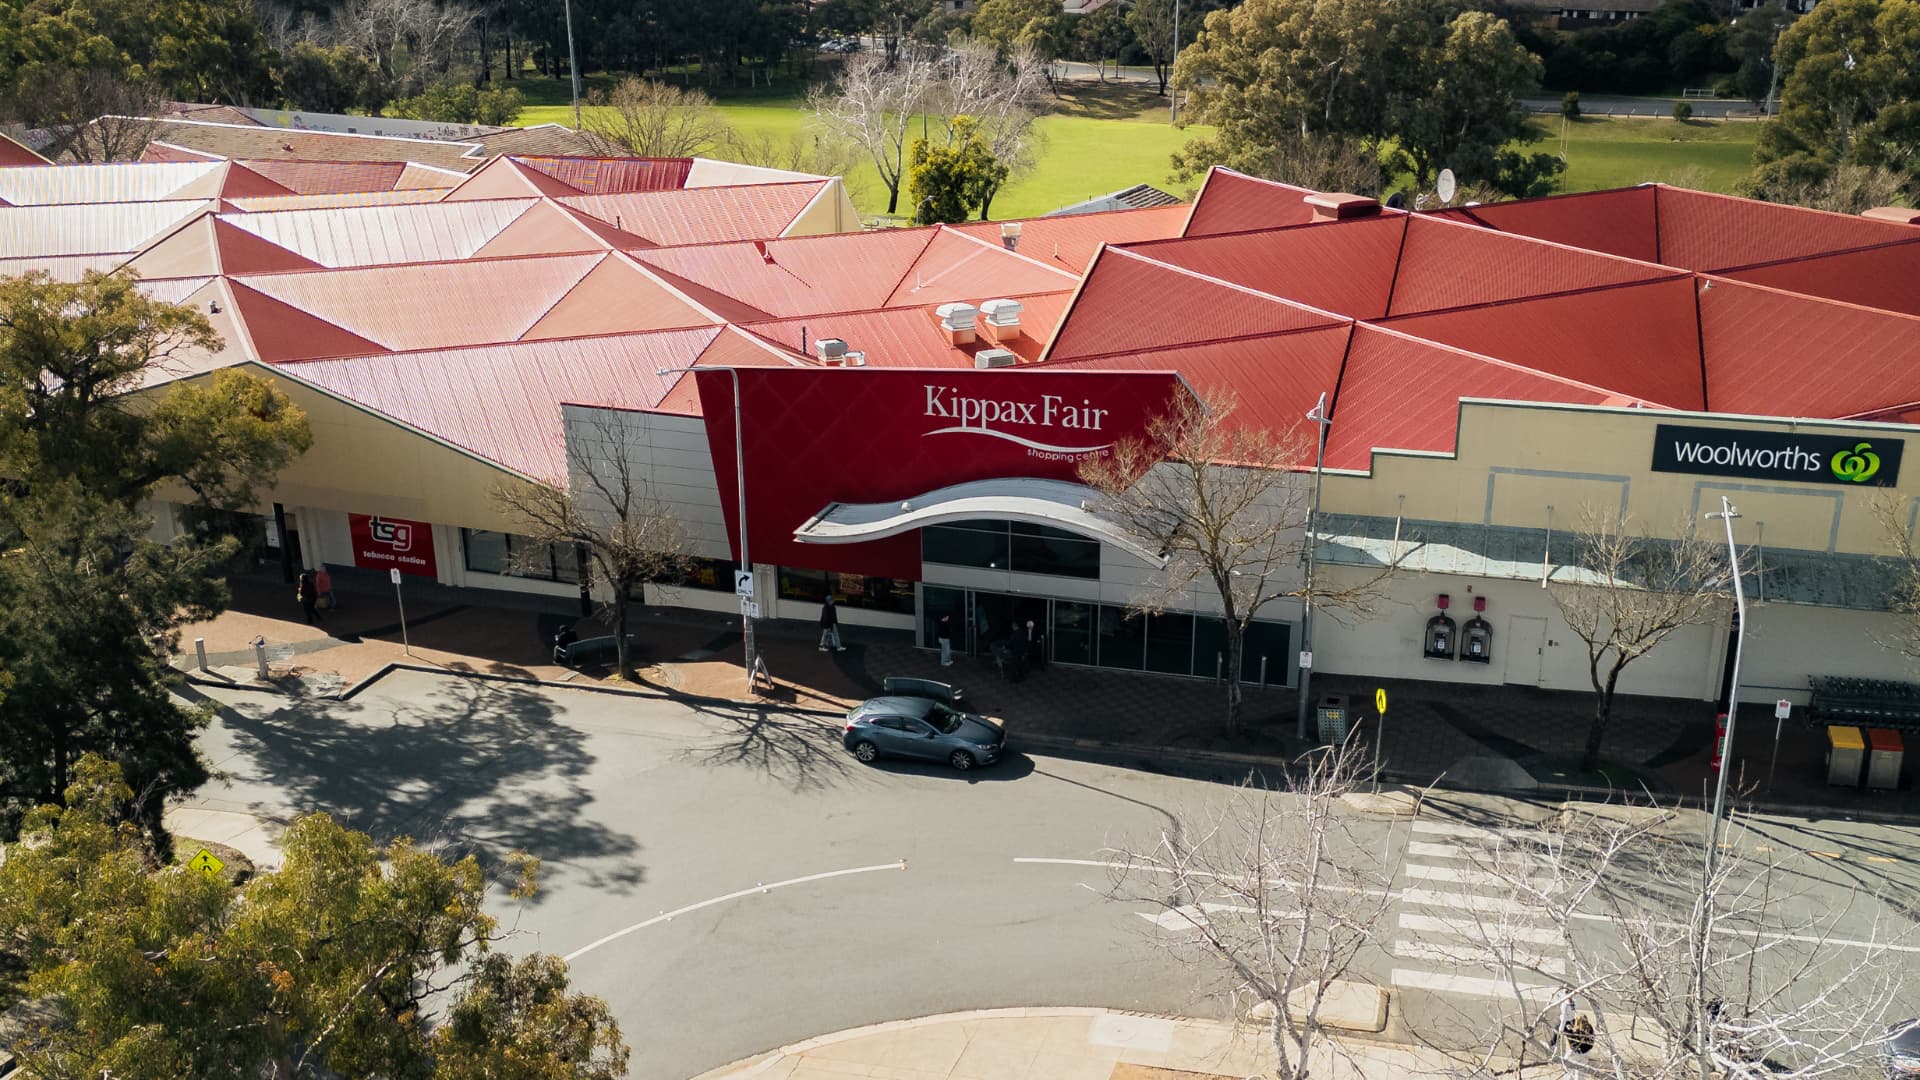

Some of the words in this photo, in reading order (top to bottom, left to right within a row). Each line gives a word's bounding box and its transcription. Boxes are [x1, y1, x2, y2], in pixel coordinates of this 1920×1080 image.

[923, 385, 1037, 429] Kippax
[1040, 394, 1109, 430] Fair
[1027, 448, 1074, 463] shopping
[1675, 440, 1821, 472] Woolworths
[369, 514, 412, 551] tsg
[363, 551, 395, 561] tobacco
[398, 555, 426, 565] station
